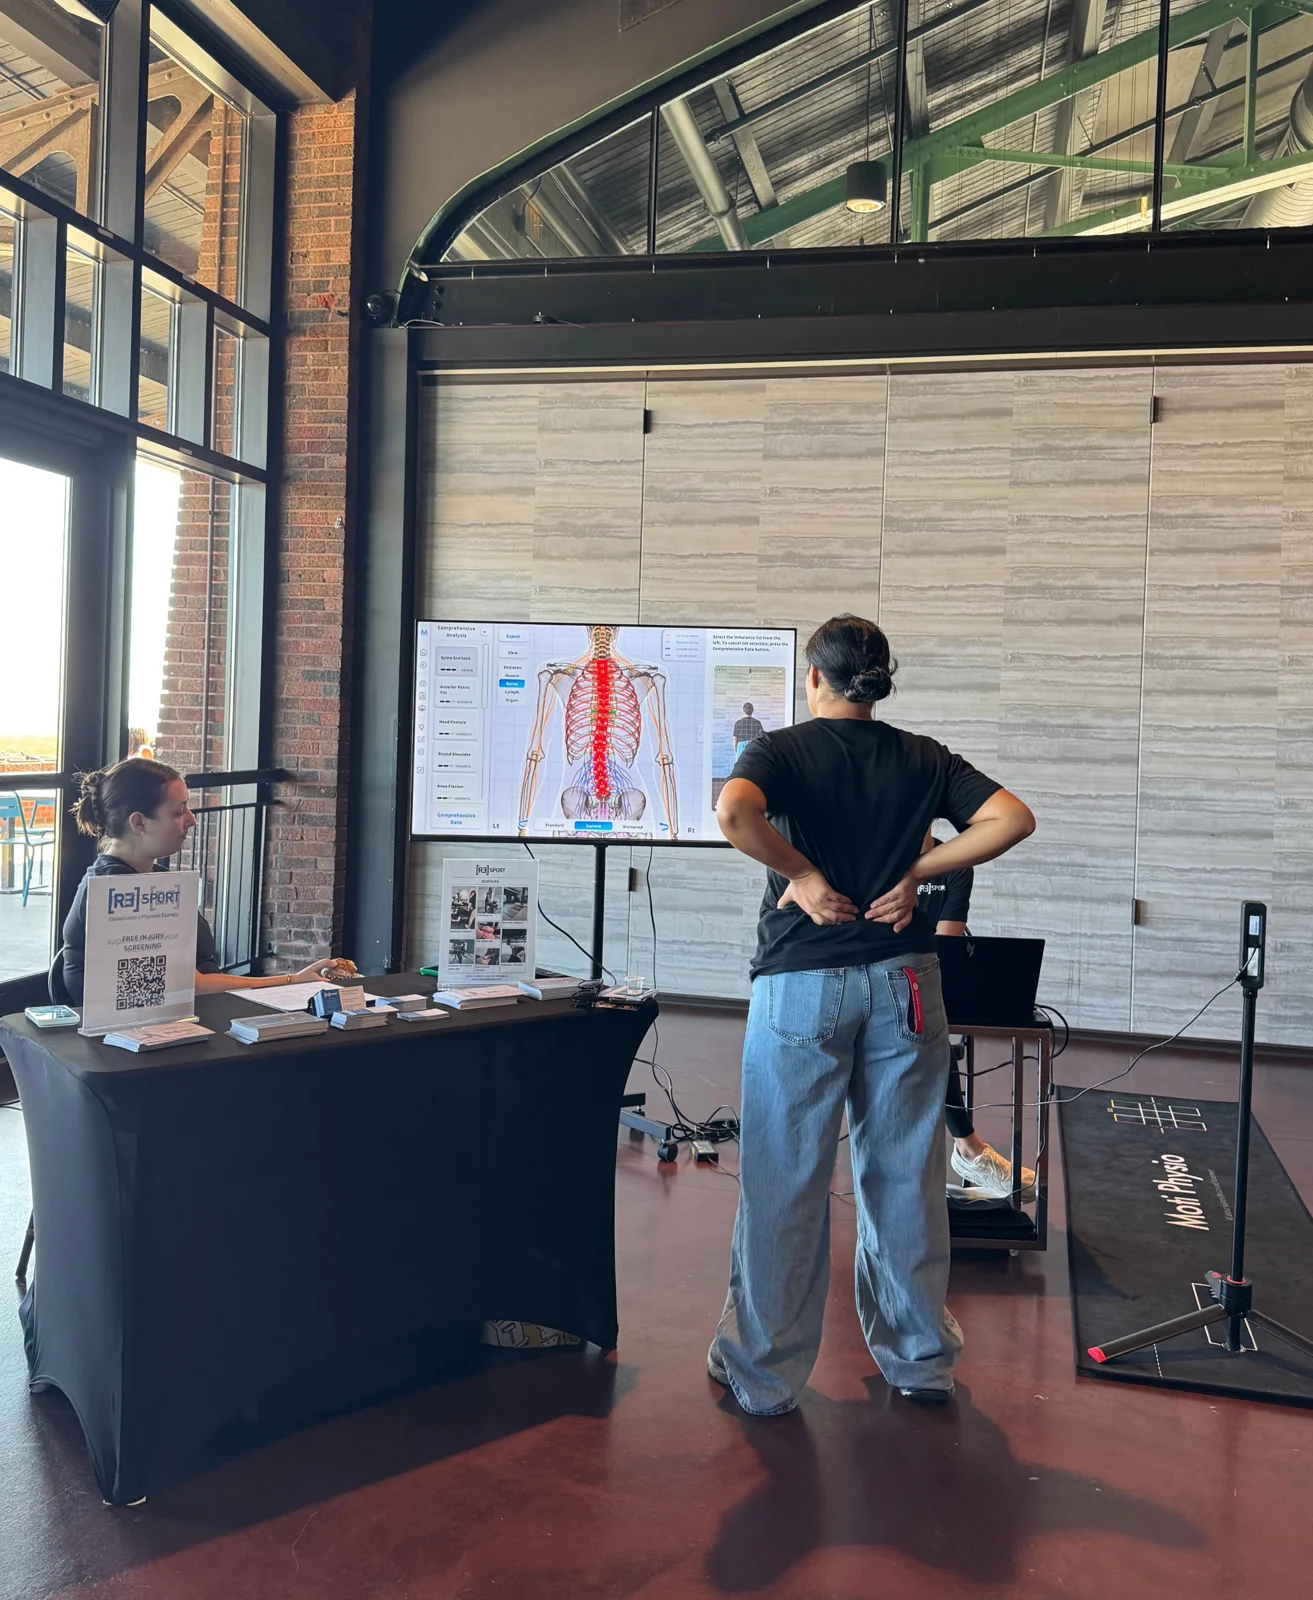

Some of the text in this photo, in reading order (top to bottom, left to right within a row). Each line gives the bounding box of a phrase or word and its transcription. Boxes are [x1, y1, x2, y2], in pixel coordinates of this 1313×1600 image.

[141, 891, 180, 904] SPORT
[124, 943, 162, 951] SCREENING
[1152, 1154, 1203, 1194] Physio
[1161, 1194, 1210, 1231] Moti
